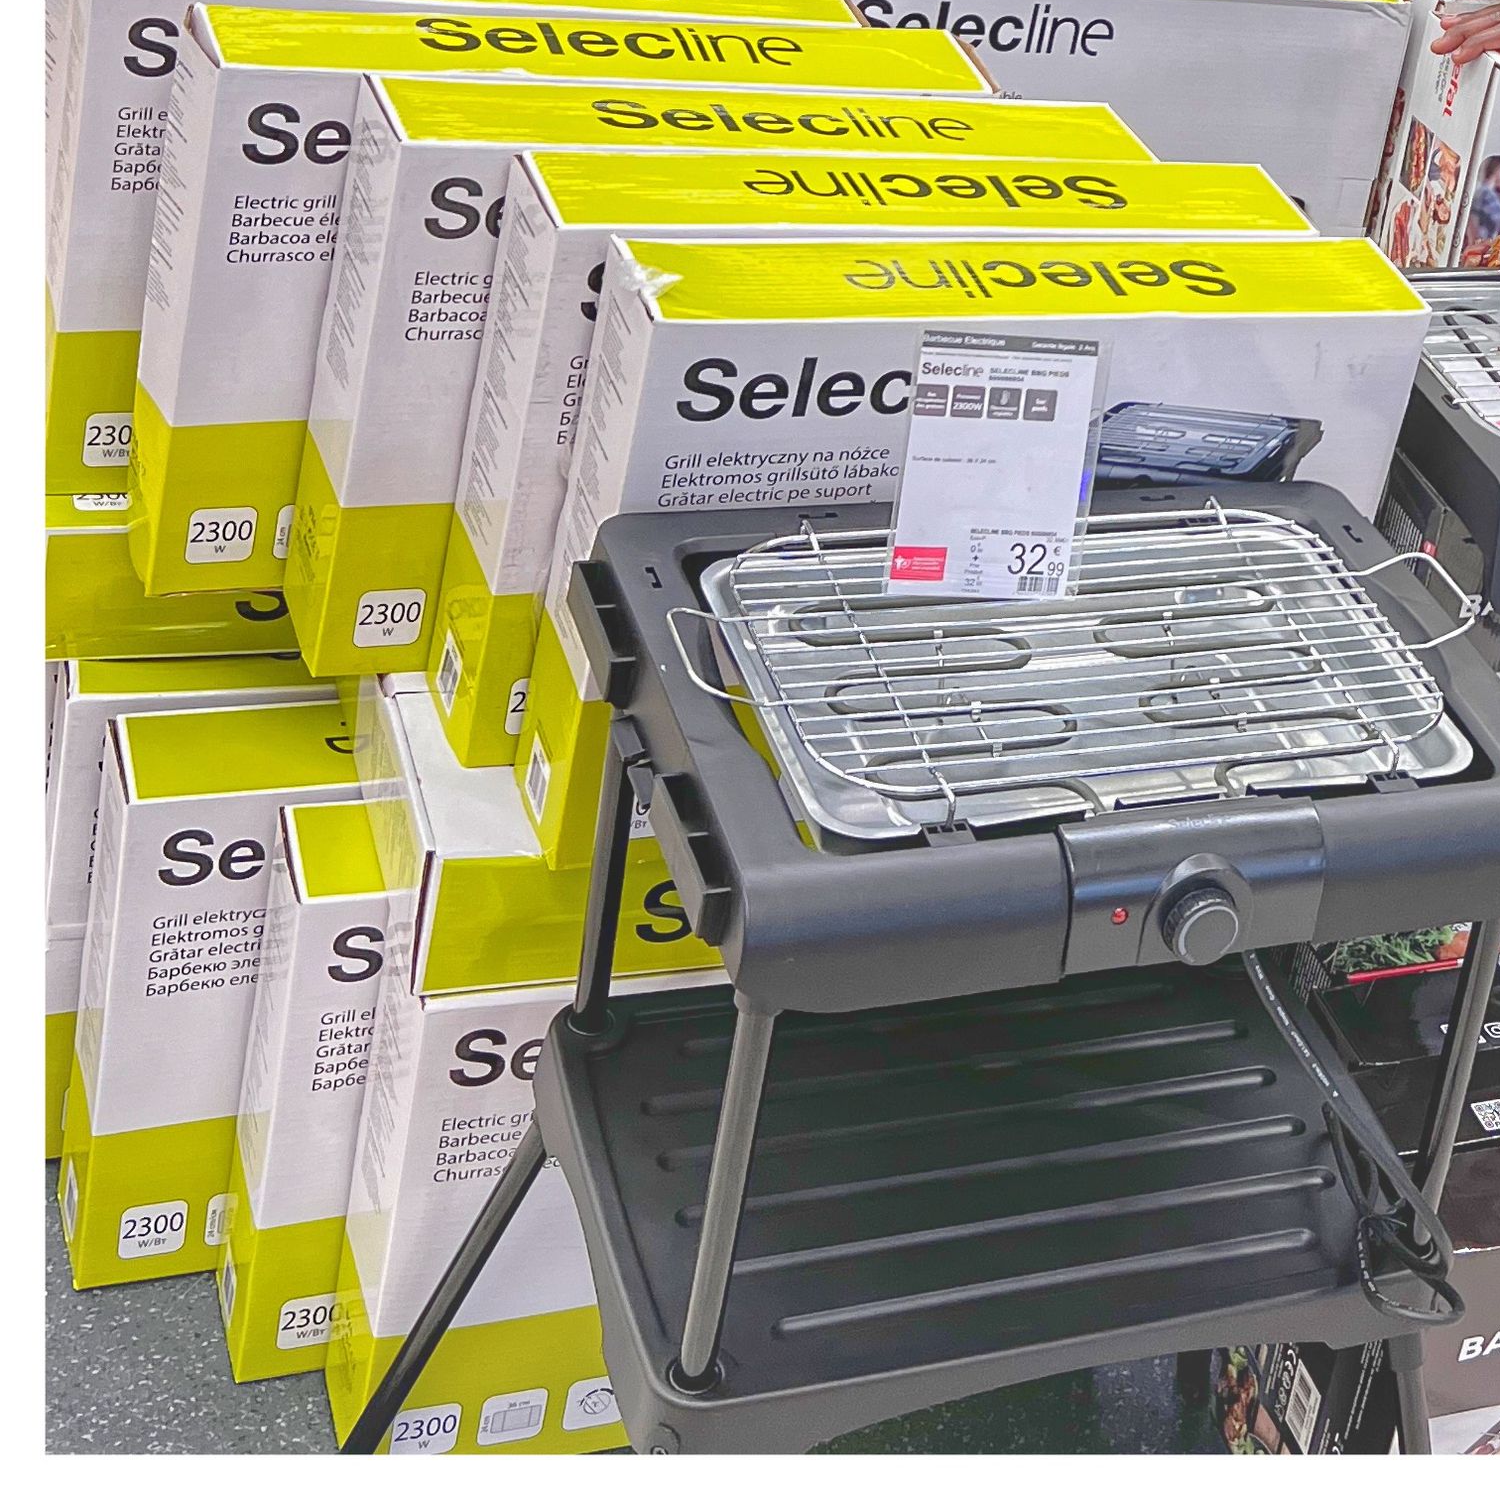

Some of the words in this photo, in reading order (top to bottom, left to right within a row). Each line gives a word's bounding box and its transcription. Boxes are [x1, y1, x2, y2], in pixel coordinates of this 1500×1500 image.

[415, 16, 804, 68] Selecline
[118, 106, 154, 122] Grill
[592, 97, 975, 143] Selecline
[116, 123, 166, 139] Elektr
[242, 101, 353, 166] Se
[743, 167, 1130, 210] Selecline
[234, 195, 300, 210] Electric
[303, 194, 337, 212] grill
[232, 213, 315, 228] Barbecue
[229, 231, 311, 246] Barbacoa
[226, 248, 315, 264] Churrasco
[414, 271, 480, 287] Electric
[843, 256, 1238, 299] Selecline
[411, 289, 491, 305] Barbecue
[408, 308, 489, 324] Barbacoa
[921, 360, 984, 378] Selecline
[675, 355, 914, 423] Selec
[665, 454, 703, 472] Grill
[708, 449, 810, 470] elektryczny
[813, 449, 834, 464] na
[839, 445, 891, 462] nóżce
[661, 470, 766, 489] Elektromos
[767, 465, 840, 487] grillsütő
[657, 490, 715, 508] Grătar
[718, 486, 784, 505] electric
[787, 488, 810, 504] pe
[814, 482, 873, 501] suport
[189, 519, 254, 544] 2300
[214, 544, 227, 554] W
[1007, 542, 1048, 576] 32
[1047, 561, 1066, 578] 99
[357, 601, 422, 627] 2300
[382, 627, 394, 637] W
[158, 828, 267, 888] Se
[152, 913, 192, 930] Grill
[151, 924, 249, 947] Elektromos
[149, 946, 204, 964] Grătar
[207, 938, 262, 958] electri
[147, 959, 228, 980] Барбекю
[145, 976, 226, 997] Барбекю
[320, 1010, 356, 1026] Grill
[316, 1041, 371, 1059] Grătar
[441, 1114, 506, 1133] Electric
[438, 1128, 523, 1150] Barbecue
[122, 1210, 184, 1240] 2300
[393, 1414, 458, 1444] 2300
